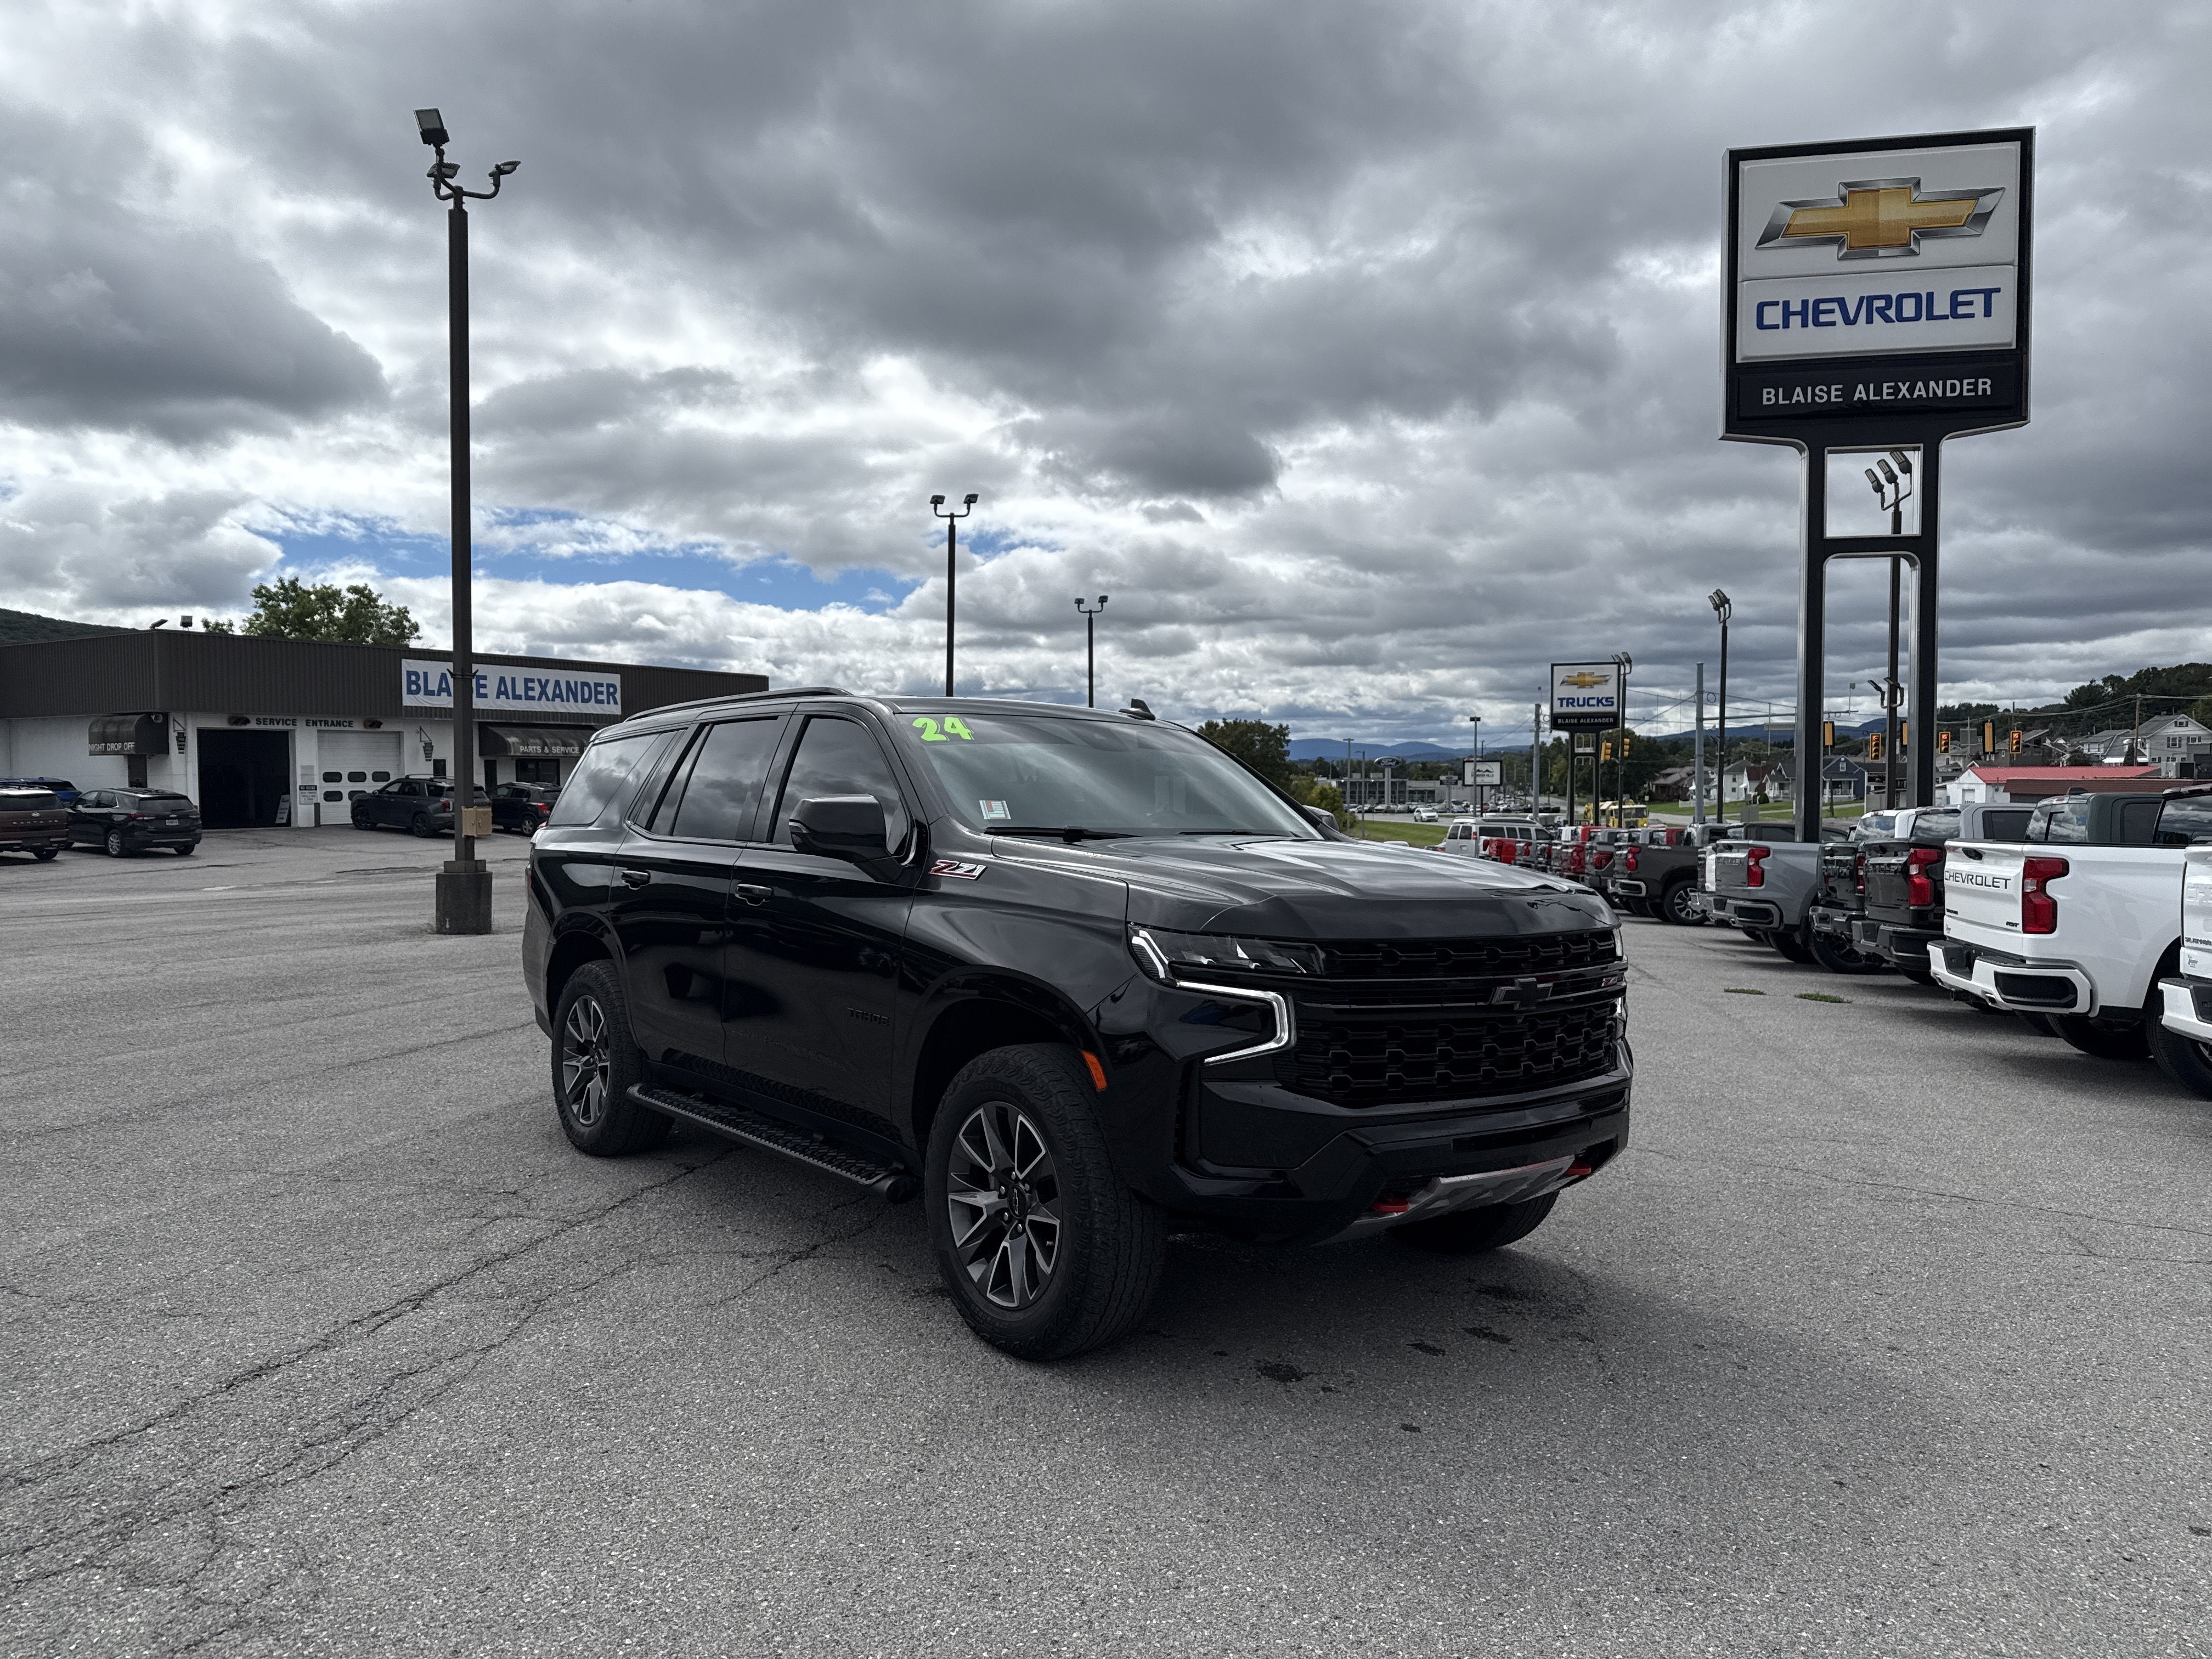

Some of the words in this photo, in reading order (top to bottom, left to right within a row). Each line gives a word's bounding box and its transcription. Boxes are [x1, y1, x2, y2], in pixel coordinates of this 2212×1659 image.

[1756, 287, 2001, 330] CHEVROLET
[1762, 385, 1843, 405] BLAISE
[1853, 378, 1991, 401] ALEXANDER
[406, 670, 488, 699] BLAE
[495, 675, 619, 705] ALEXANDER
[1558, 697, 1615, 708] TRUCKS
[256, 718, 297, 726] SERVICE
[306, 719, 354, 727] ENTRANCE
[912, 716, 975, 741] 24
[106, 742, 121, 751] DROP
[123, 742, 135, 751] OFF
[928, 859, 987, 881] Z71
[1945, 870, 2011, 889] CHEVROLET
[847, 1007, 890, 1026] TAHOE
